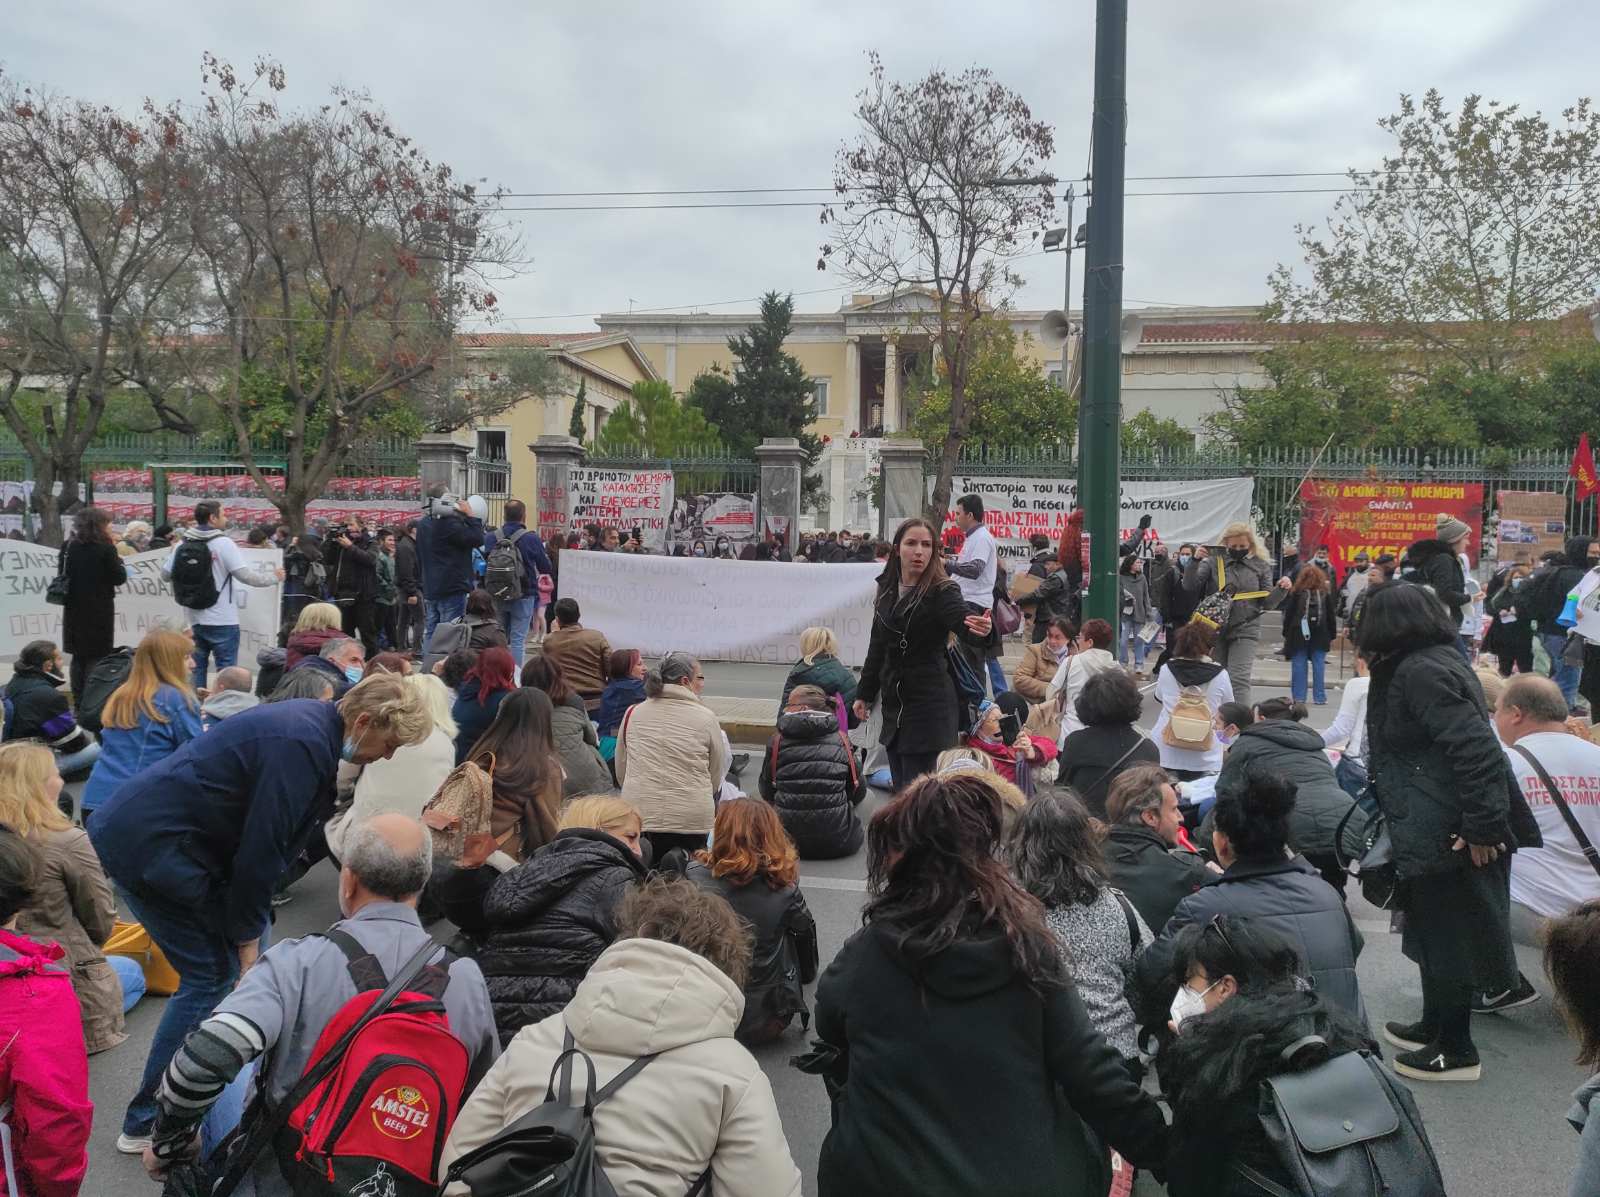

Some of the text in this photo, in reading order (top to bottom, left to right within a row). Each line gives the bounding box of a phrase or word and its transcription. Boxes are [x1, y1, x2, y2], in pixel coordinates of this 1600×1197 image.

[587, 471, 616, 482] ΔΡΟΜΟ
[619, 472, 633, 481] ΤΟΥ
[583, 482, 597, 493] ΤΙΣ
[1033, 485, 1053, 493] του
[1411, 486, 1465, 499] ΝΟΕΜΒΡΗ
[579, 494, 595, 505] ΚΑΙ
[1119, 497, 1189, 511] ολυτεχνεία
[371, 1094, 429, 1127] AMSTEL
[384, 1117, 408, 1134] BEER
